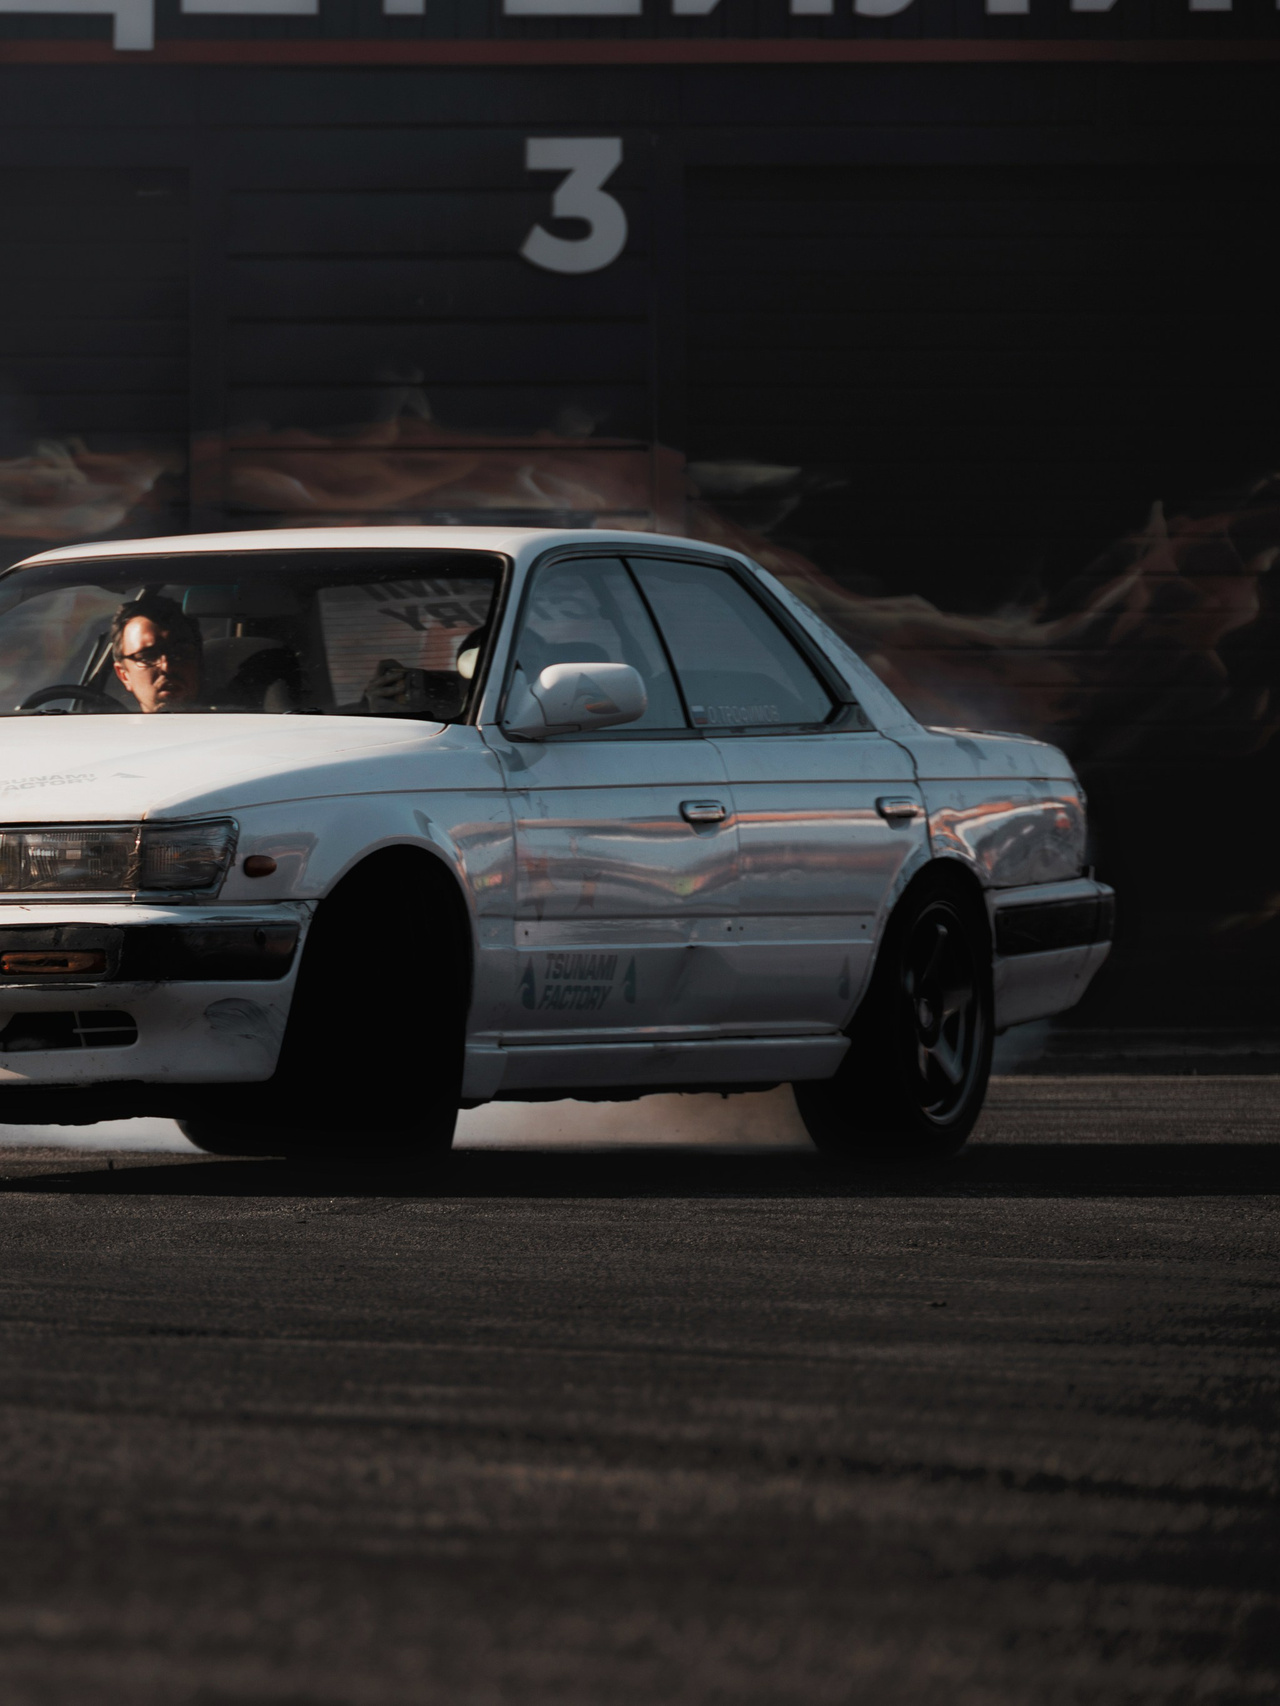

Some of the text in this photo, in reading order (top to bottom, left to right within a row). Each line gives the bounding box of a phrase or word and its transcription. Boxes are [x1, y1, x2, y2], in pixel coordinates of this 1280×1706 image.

[519, 136, 628, 274] 3
[545, 953, 618, 980] TSUNAMI
[537, 985, 613, 1010] FACTORY
